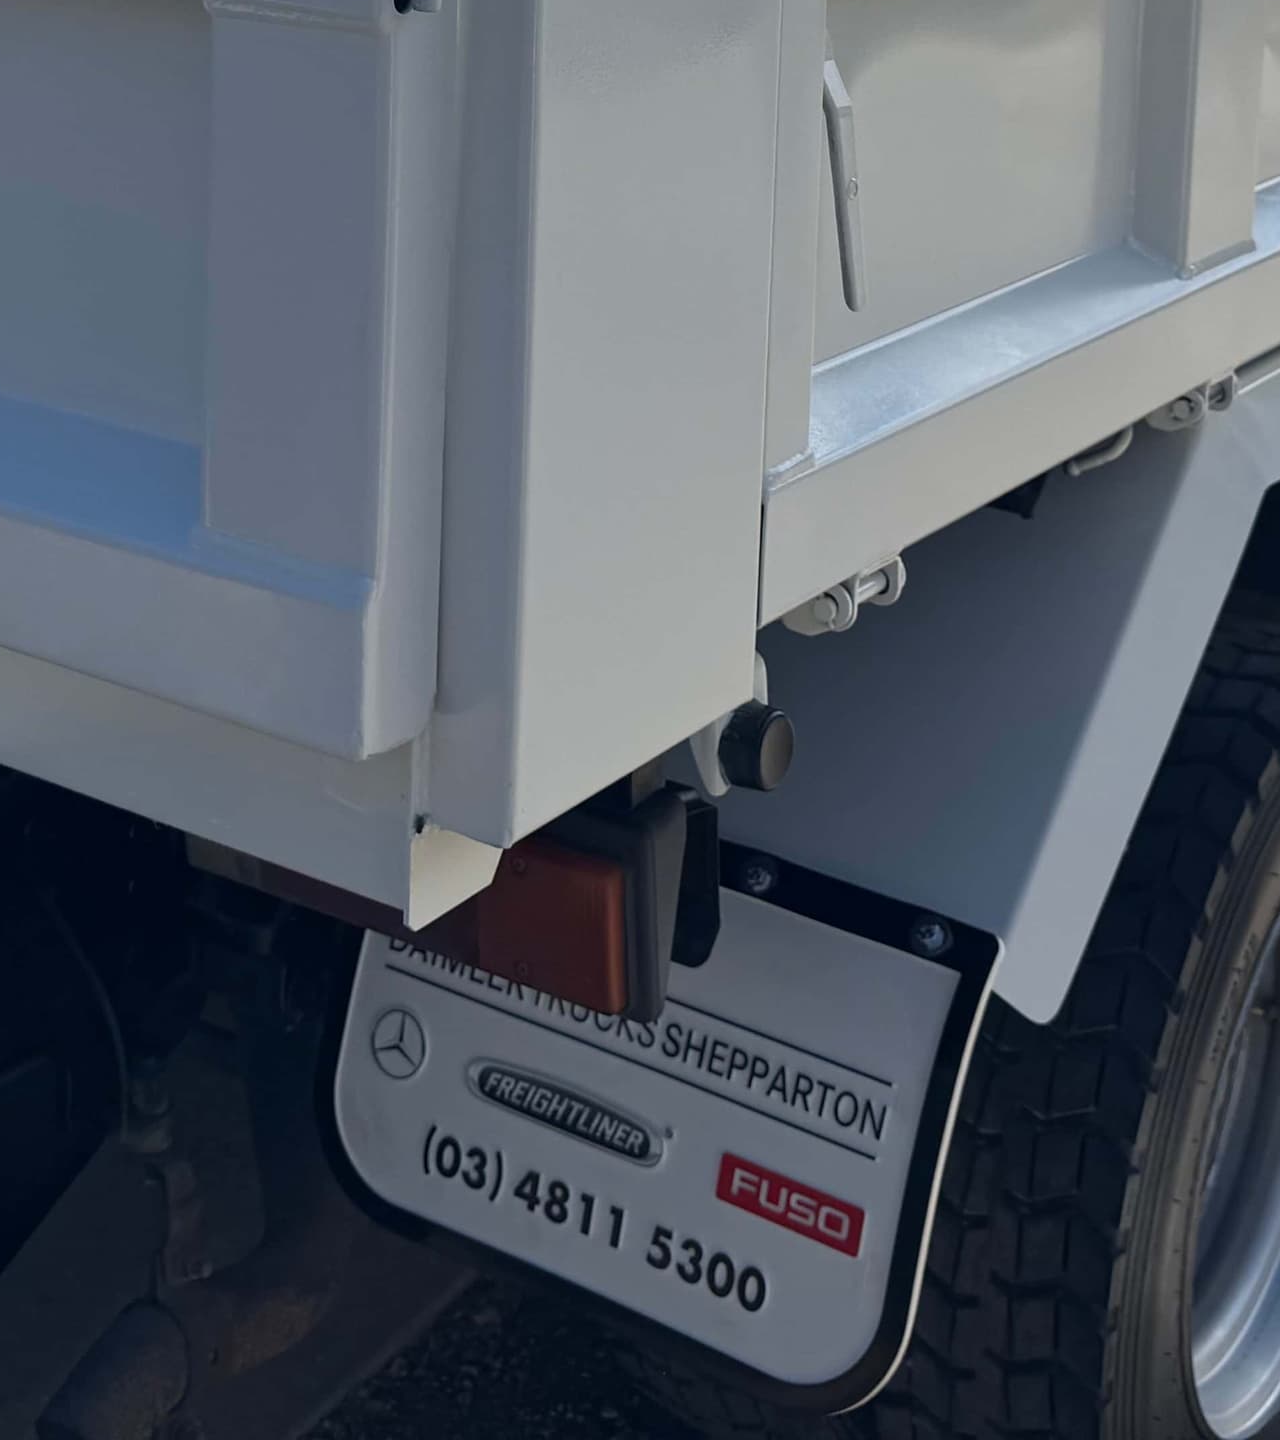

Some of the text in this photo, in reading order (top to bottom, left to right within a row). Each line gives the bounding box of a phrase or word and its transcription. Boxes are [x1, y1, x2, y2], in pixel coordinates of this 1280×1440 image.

[483, 1070, 646, 1157] FREIGHTLINER
[661, 1022, 887, 1141] SHEPPARTON
[423, 1124, 767, 1312] (03) 4811 5300
[730, 1167, 850, 1241] FUSO
